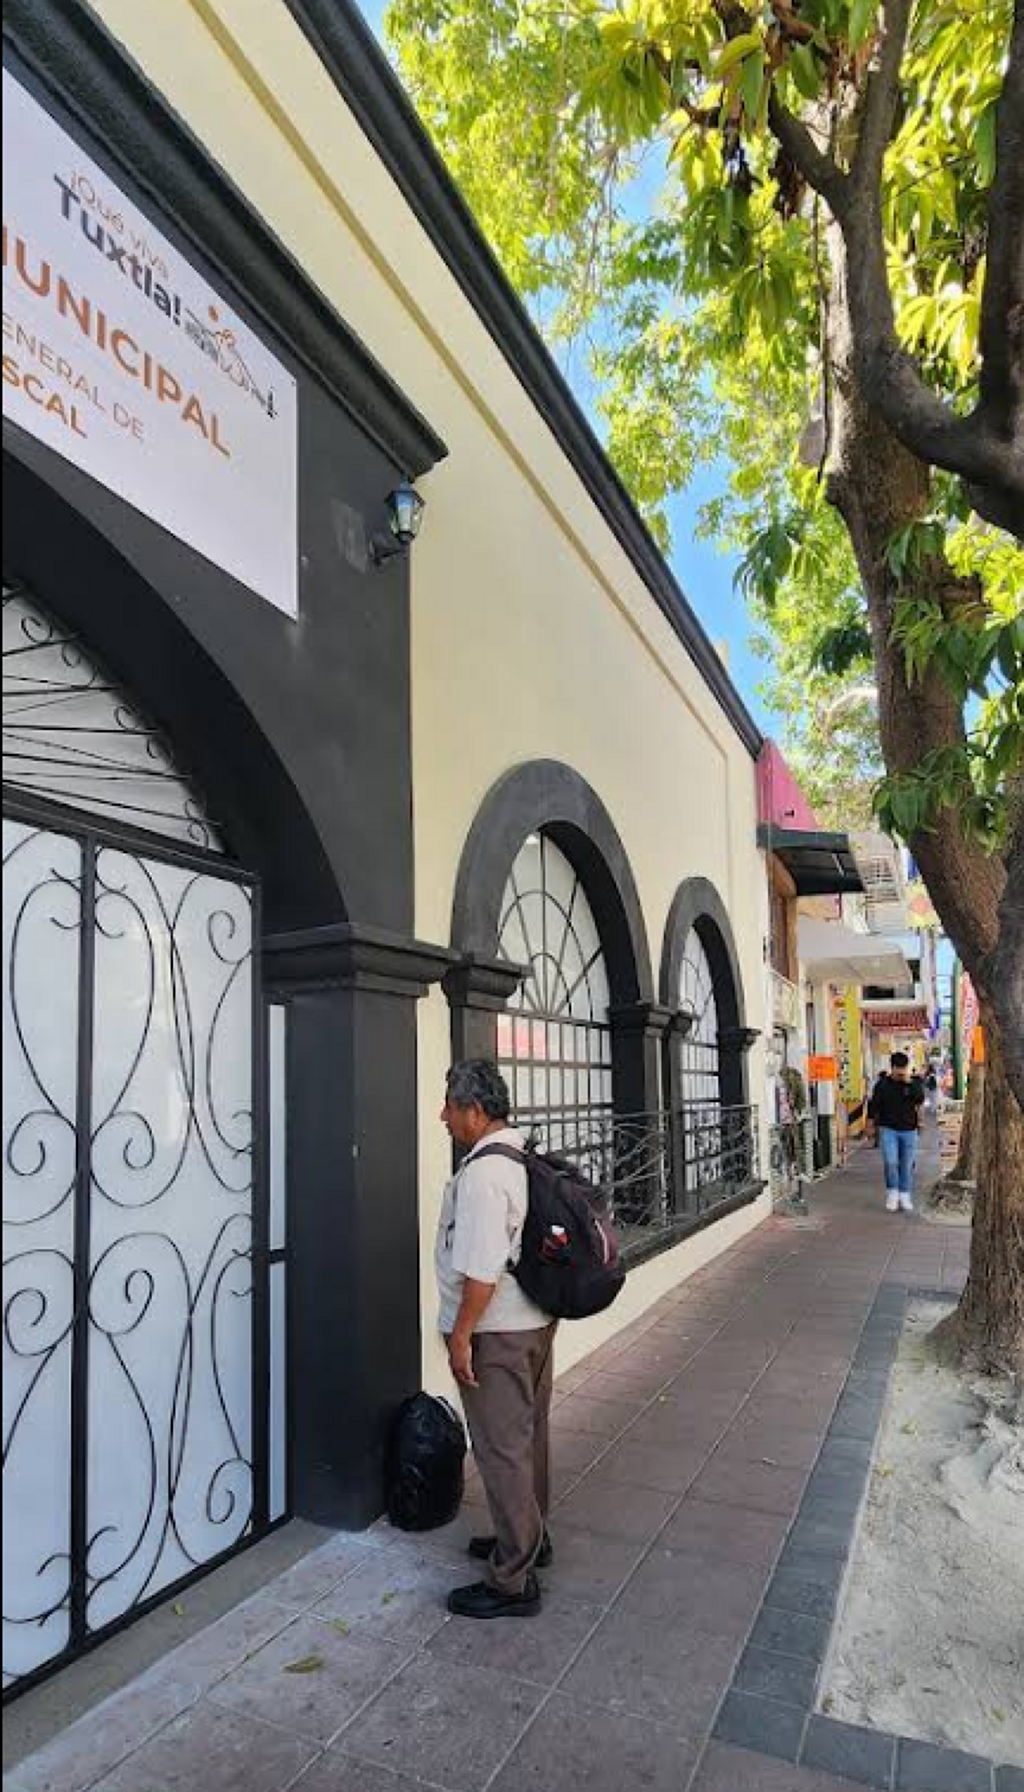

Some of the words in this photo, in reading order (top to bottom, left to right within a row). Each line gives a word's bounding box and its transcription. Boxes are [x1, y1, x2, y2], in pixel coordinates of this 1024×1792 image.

[54, 173, 180, 327] Tuxtla!
[2, 225, 230, 459] UNICIPAL
[113, 403, 145, 441] DE
